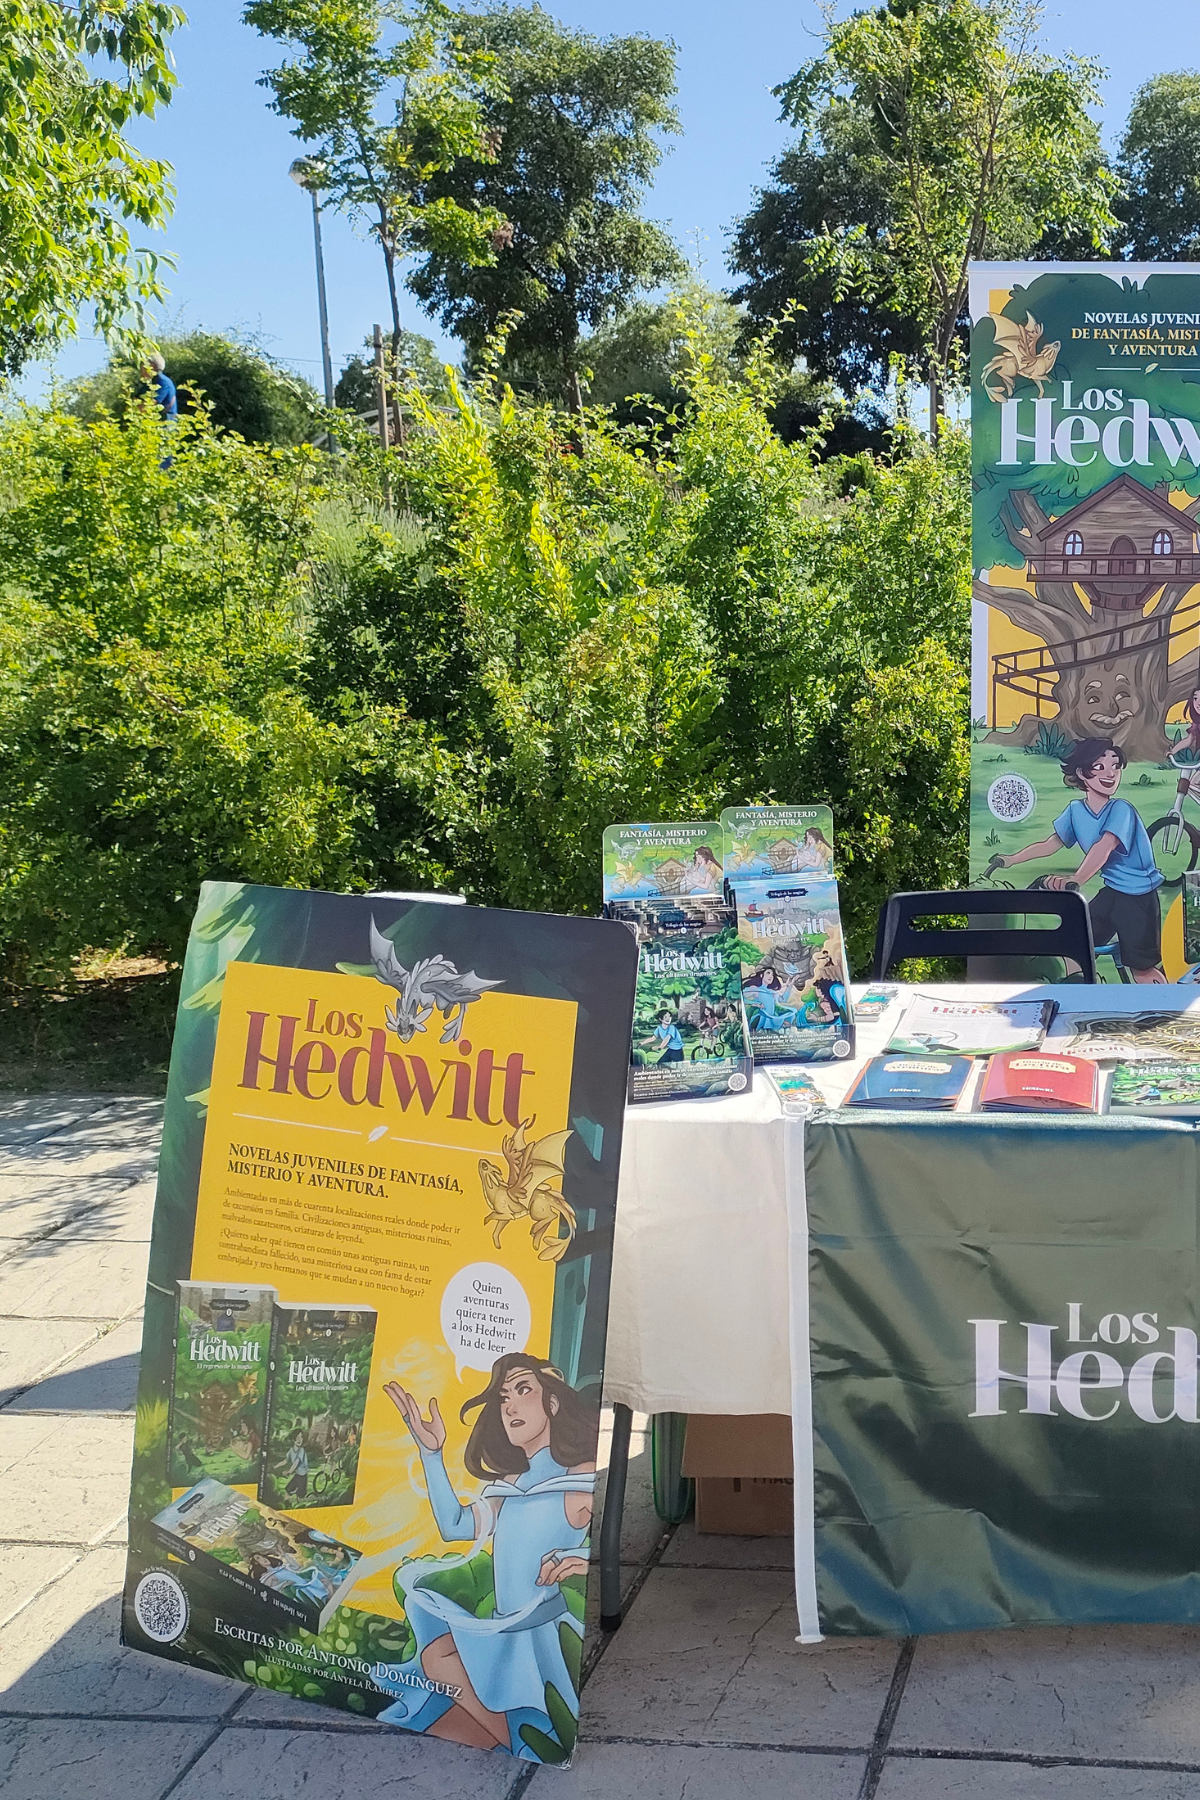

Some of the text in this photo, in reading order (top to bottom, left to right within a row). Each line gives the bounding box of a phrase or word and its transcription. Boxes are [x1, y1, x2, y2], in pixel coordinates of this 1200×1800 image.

[1084, 312, 1147, 325] NOVELAS
[1071, 328, 1090, 339] DE
[1093, 326, 1164, 341] FANTASÍA,
[1108, 344, 1198, 356] Y AVENTURA
[1061, 381, 1124, 411] Los
[736, 810, 817, 821] FANTASÍA, MISTERIO
[758, 818, 802, 826] AVENTURA
[620, 828, 707, 839] FANTASÍA, MISTERIO
[636, 837, 691, 846] Y AVENTURA
[752, 918, 826, 938] Hedwitt
[644, 952, 726, 972] Hedwitt
[661, 949, 678, 957] Los
[304, 998, 364, 1039] Los
[237, 1010, 537, 1129] Hedwitt
[229, 1143, 464, 1195] NOVELAS JUVENILES DE FANTASÍA,
[228, 1160, 389, 1199] MISTERIO Y AVENTURA.
[473, 1280, 502, 1294] Quien
[463, 1295, 509, 1310] aventuras
[456, 1308, 514, 1325] quiera tener
[1066, 1302, 1160, 1344] Los
[460, 1321, 516, 1340] los Hedwitt
[190, 1341, 261, 1362] Hedwitt
[460, 1335, 505, 1353] ha de leer
[288, 1360, 358, 1383] Hedwitt
[214, 1617, 463, 1699] ESCRITAS POR ANTONIO DOMÍNGUEZ
[265, 1655, 404, 1699] ILUSTRADAS POR ANYELA RAMÍREZ
